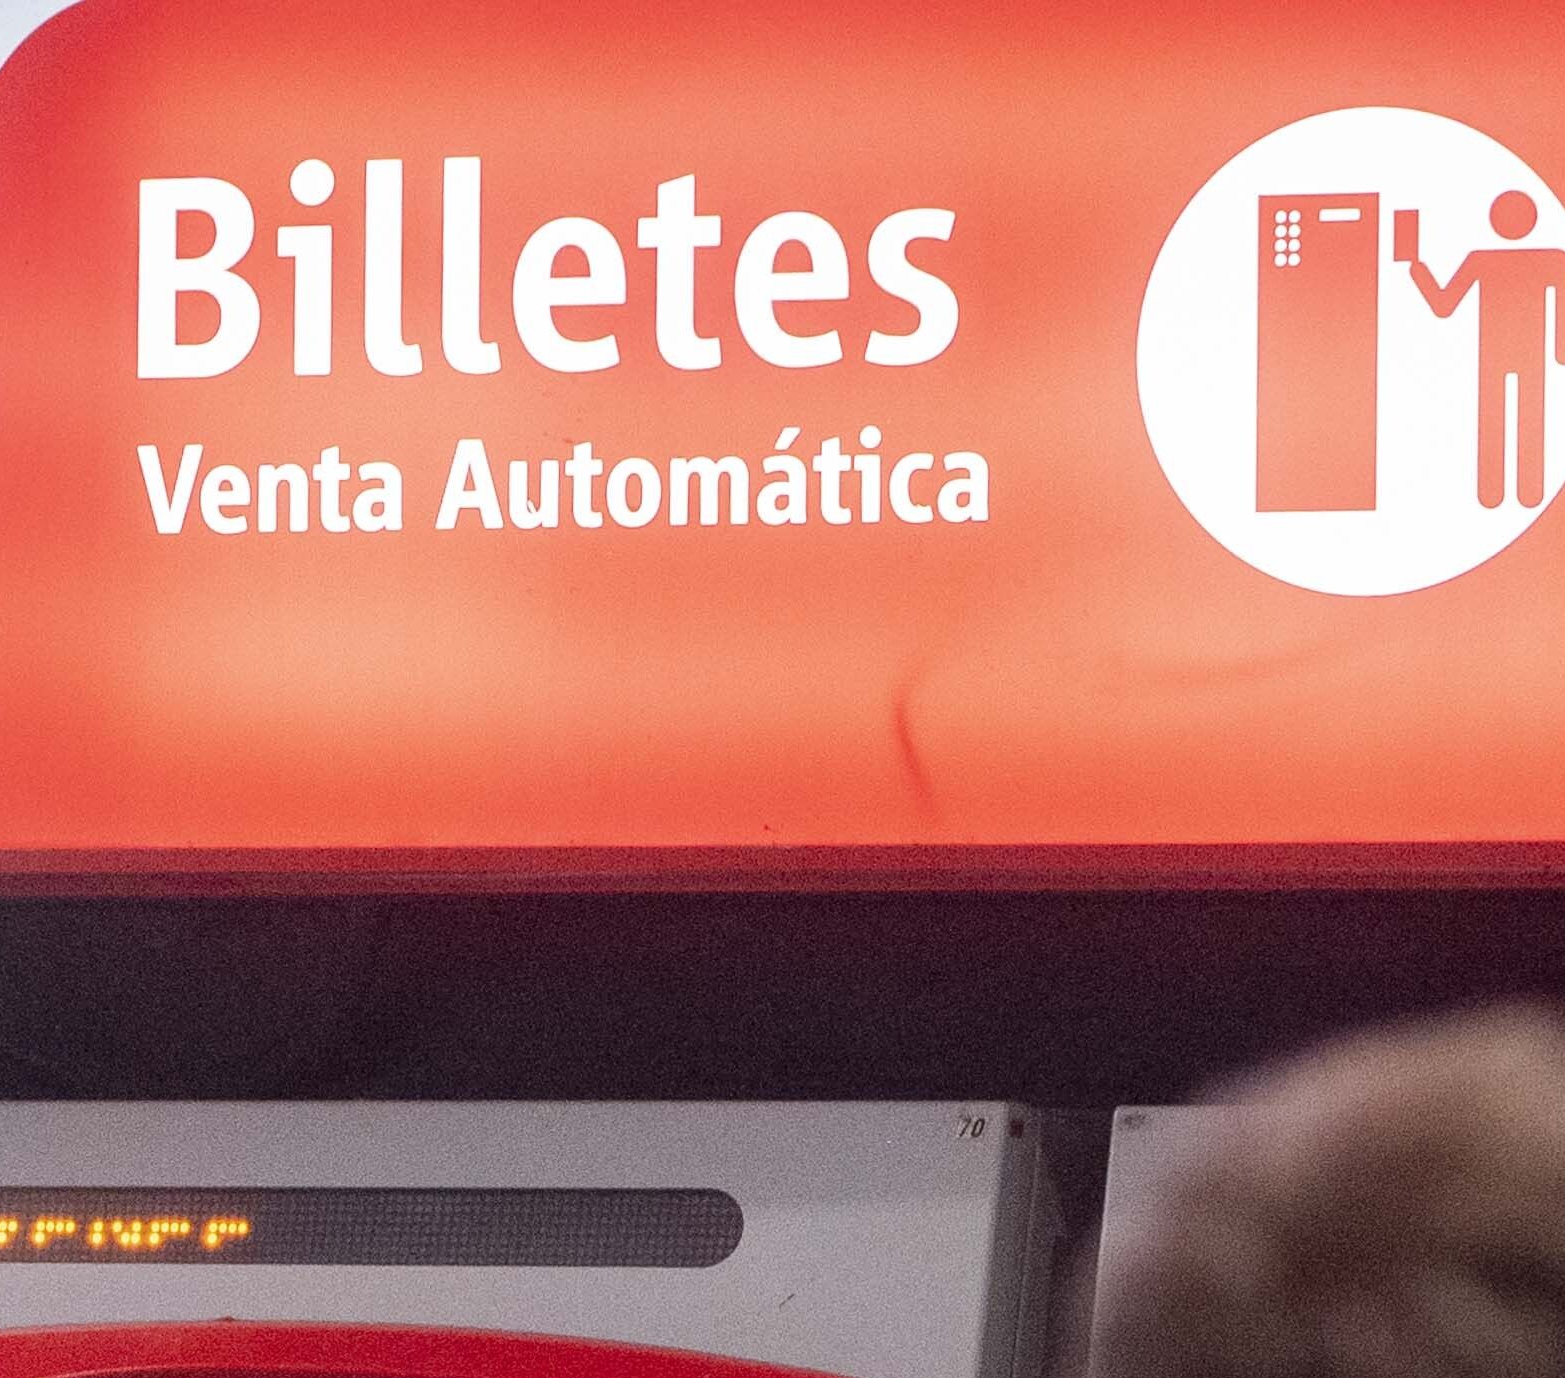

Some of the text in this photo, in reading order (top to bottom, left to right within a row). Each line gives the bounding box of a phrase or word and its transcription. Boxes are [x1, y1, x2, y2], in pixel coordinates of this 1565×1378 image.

[136, 155, 962, 381] Billetes
[136, 424, 991, 536] Venta Automática
